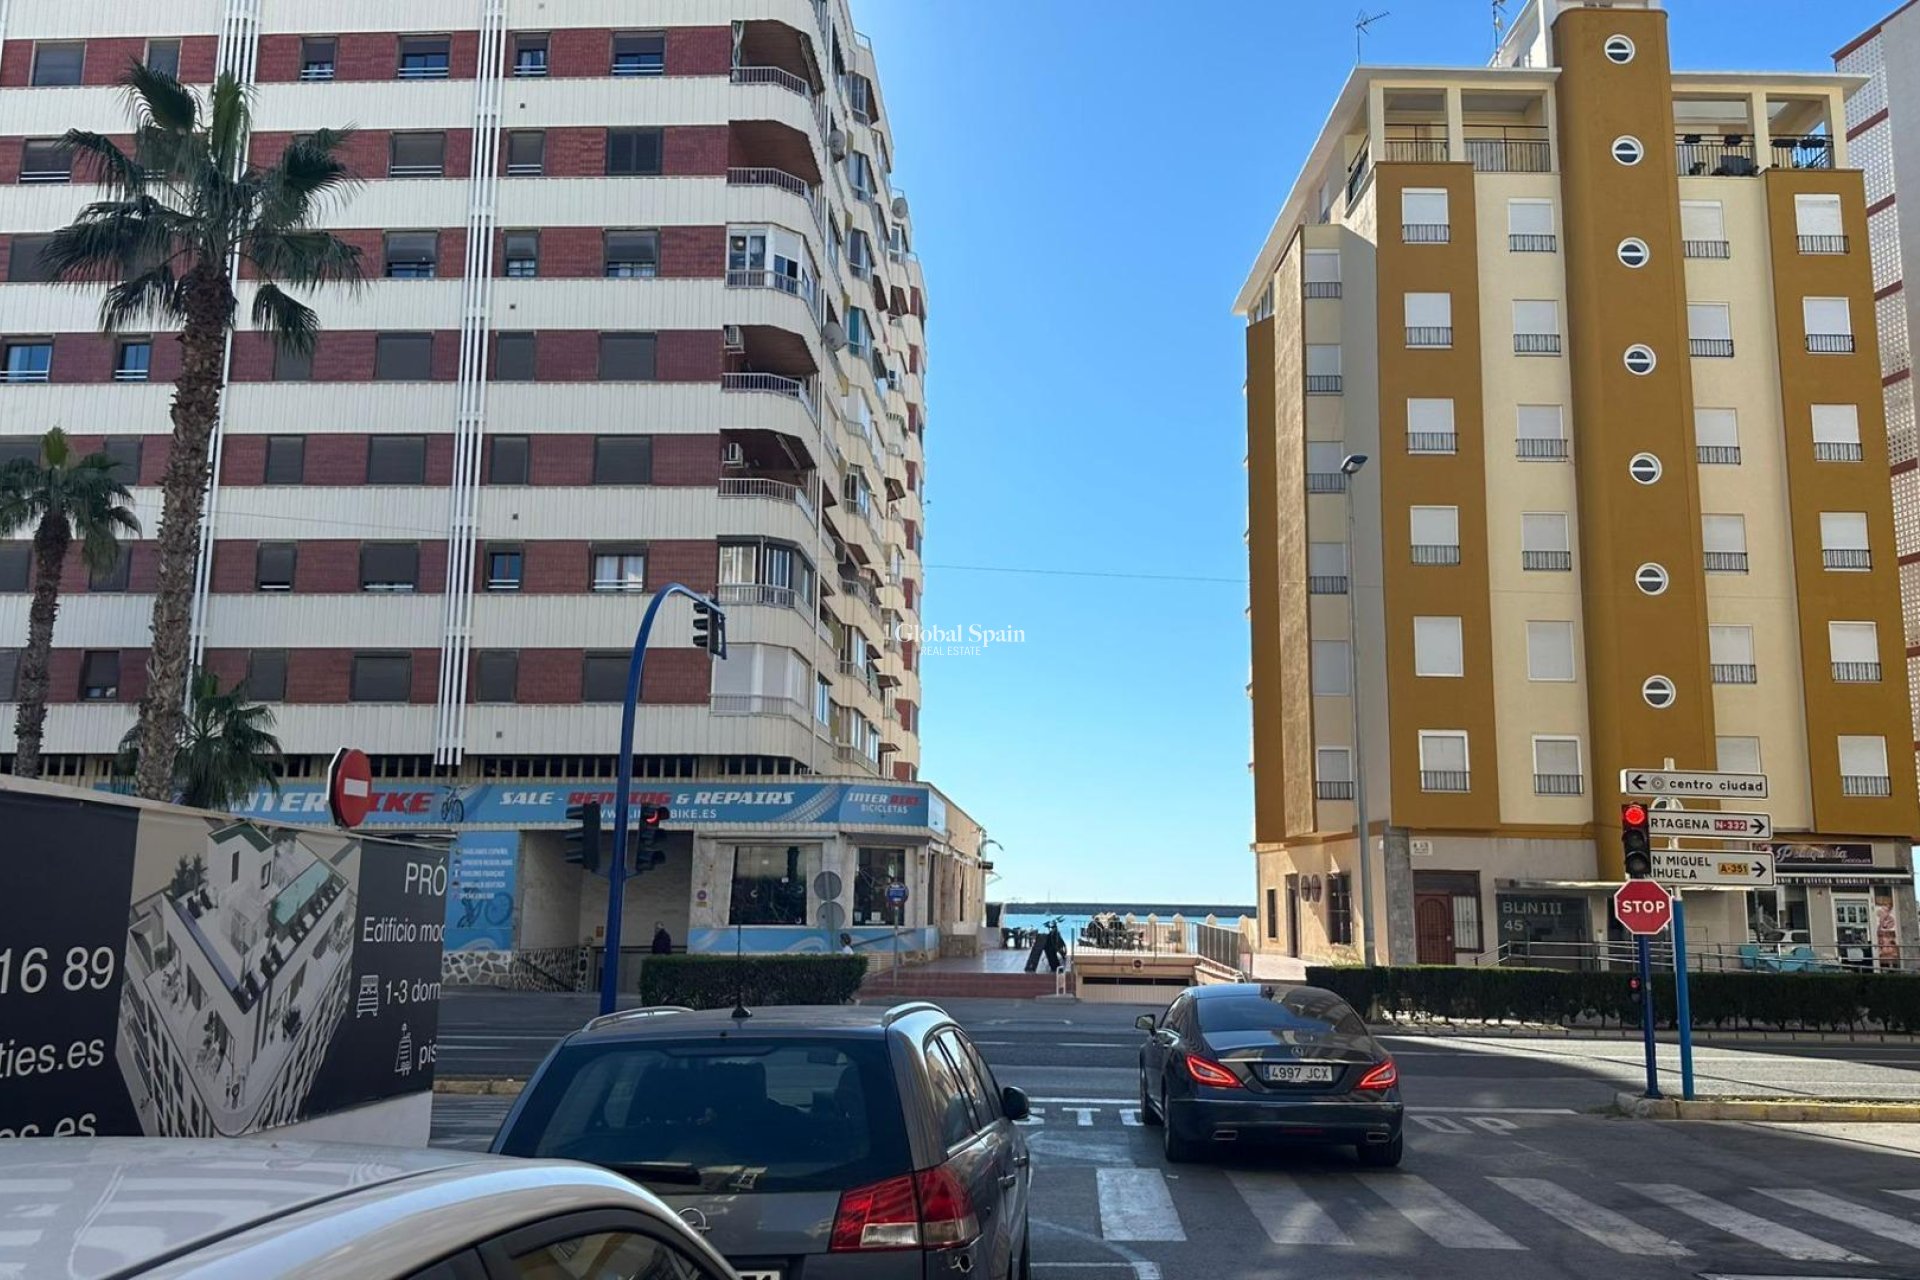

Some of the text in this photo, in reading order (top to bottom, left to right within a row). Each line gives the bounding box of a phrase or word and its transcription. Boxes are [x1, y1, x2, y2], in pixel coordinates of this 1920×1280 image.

[1669, 778, 1763, 792] centro ciudad
[367, 791, 435, 812] IKE
[500, 791, 555, 805] SALE
[694, 791, 796, 805] REPAIRS
[847, 792, 888, 804] INTER
[861, 804, 908, 814] BICICLETAS
[1650, 818, 1746, 831] RTAGENA N-332
[1666, 855, 1712, 867] MIGUEL
[1650, 868, 1697, 879] IHUELA
[1721, 863, 1748, 873] A-351
[404, 857, 447, 896] PRÓ
[1622, 900, 1666, 913] STOP
[363, 916, 417, 943] Edificio
[1504, 920, 1525, 932] 45
[62, 946, 115, 991] 89
[385, 977, 441, 1005] 1-3 dom
[418, 1039, 438, 1071] pis
[1271, 1067, 1329, 1079] 4997 JCX
[1408, 1115, 1520, 1136] OP
